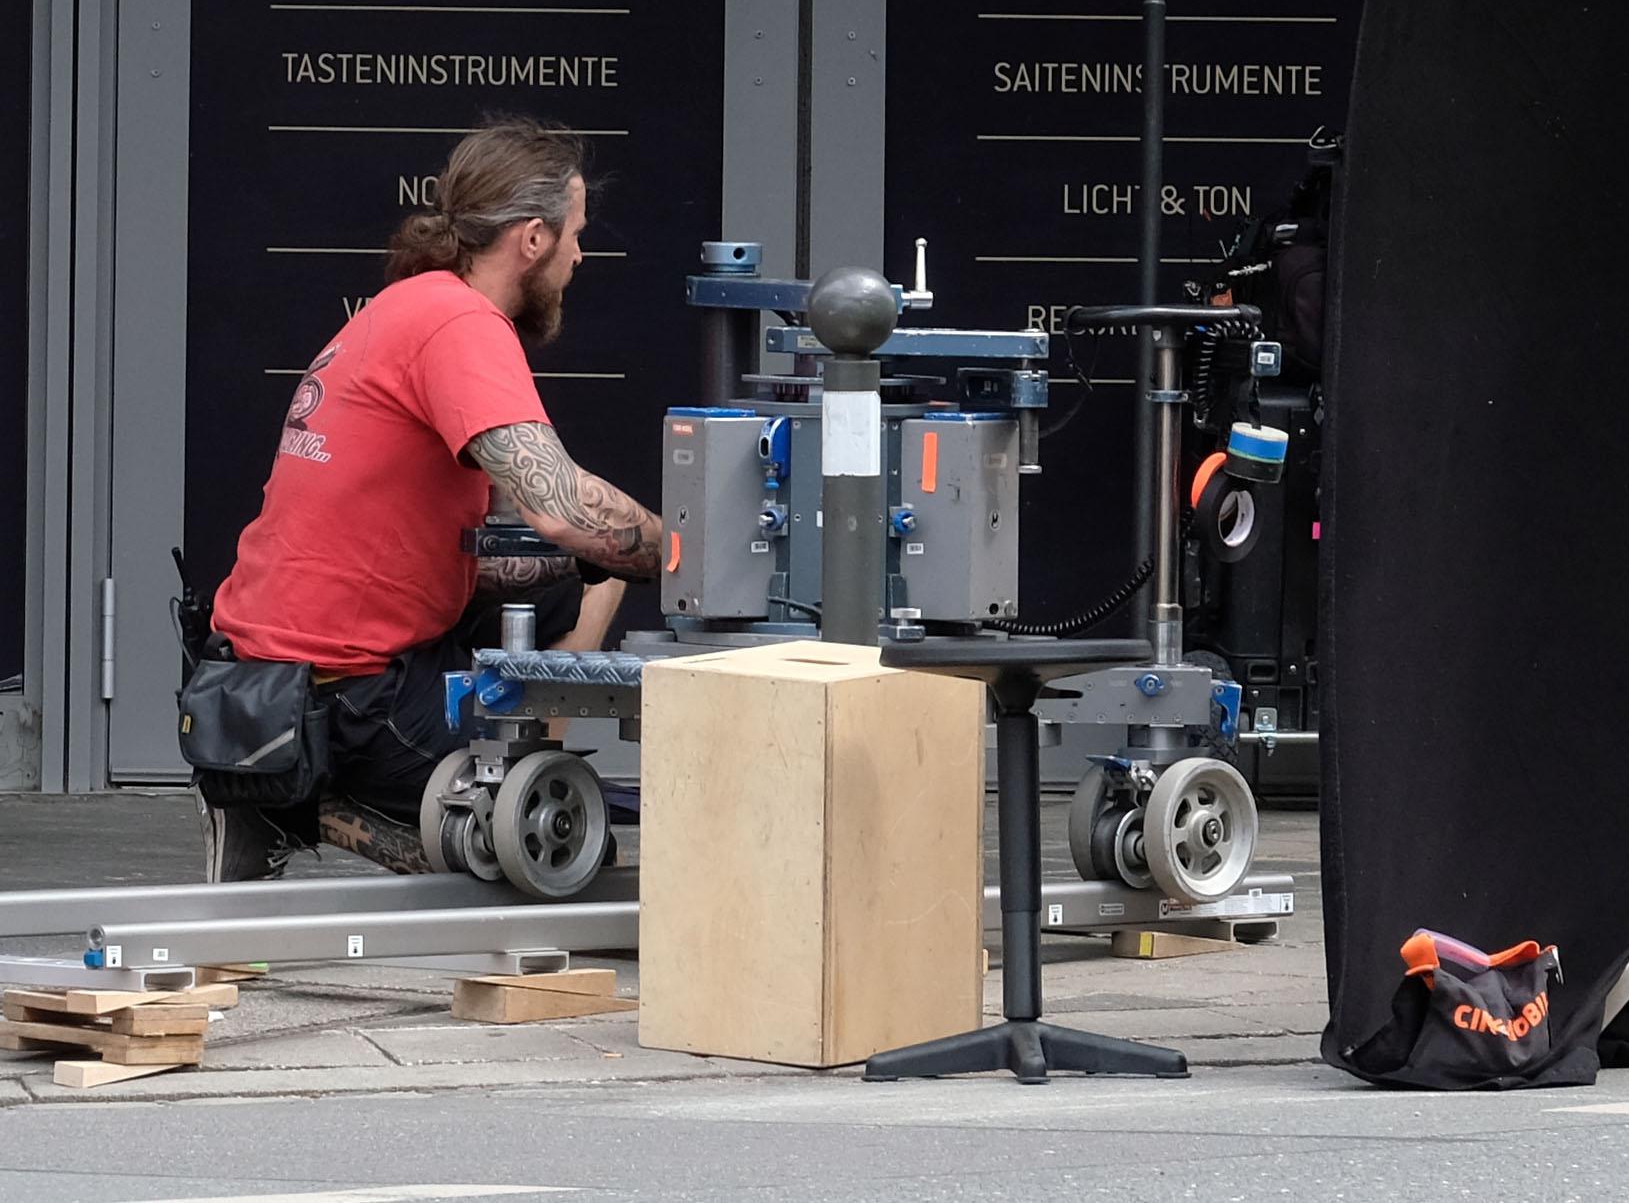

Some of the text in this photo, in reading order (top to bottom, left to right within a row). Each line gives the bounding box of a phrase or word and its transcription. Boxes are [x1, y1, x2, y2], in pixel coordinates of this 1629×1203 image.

[282, 52, 619, 88] TASTENINSTRUMENTE
[993, 62, 1322, 96] SAITENINRUMENTE
[1063, 183, 1251, 216] LICH & TON
